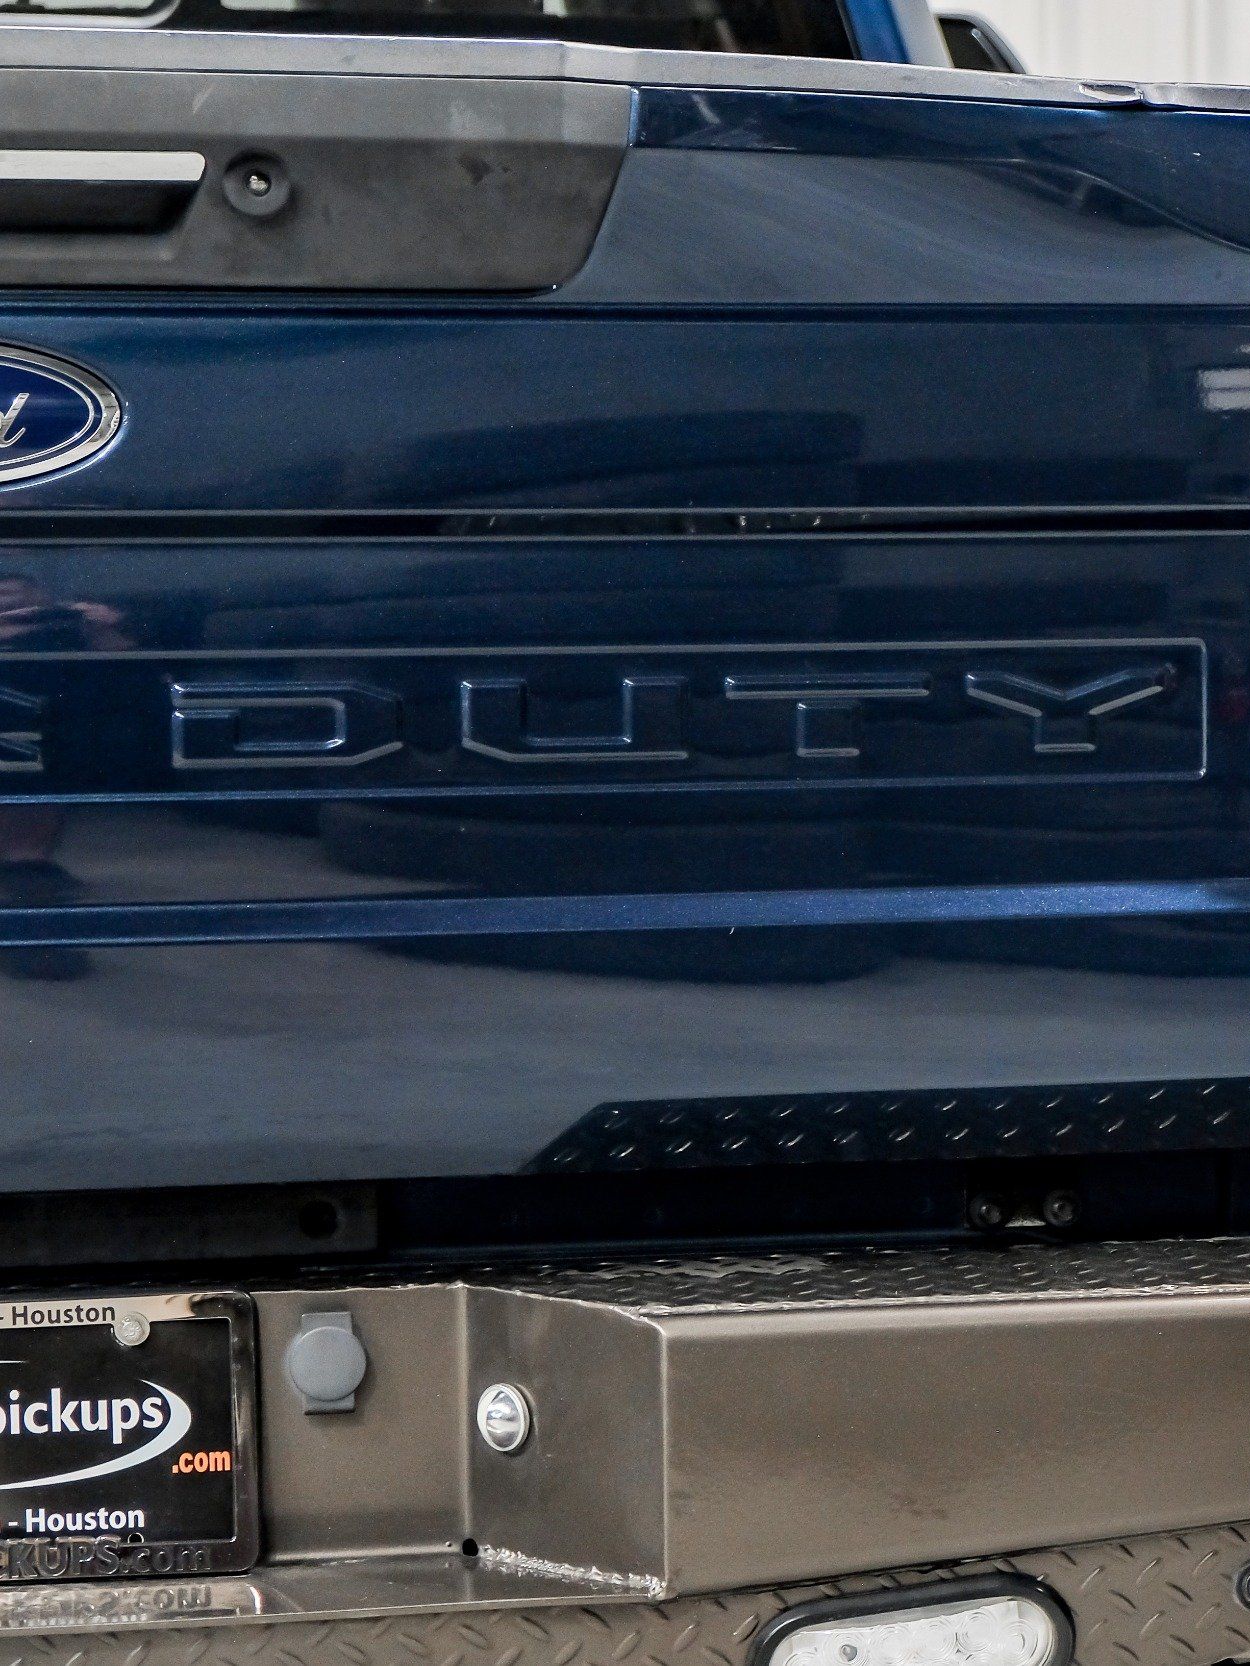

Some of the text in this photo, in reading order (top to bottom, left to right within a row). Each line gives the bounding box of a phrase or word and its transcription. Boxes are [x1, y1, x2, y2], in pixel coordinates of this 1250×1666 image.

[171, 668, 1177, 769] DUTY
[12, 1304, 116, 1326] Houston
[0, 1387, 165, 1445] ickups
[171, 1450, 231, 1474] .com
[25, 1507, 145, 1533] Houston
